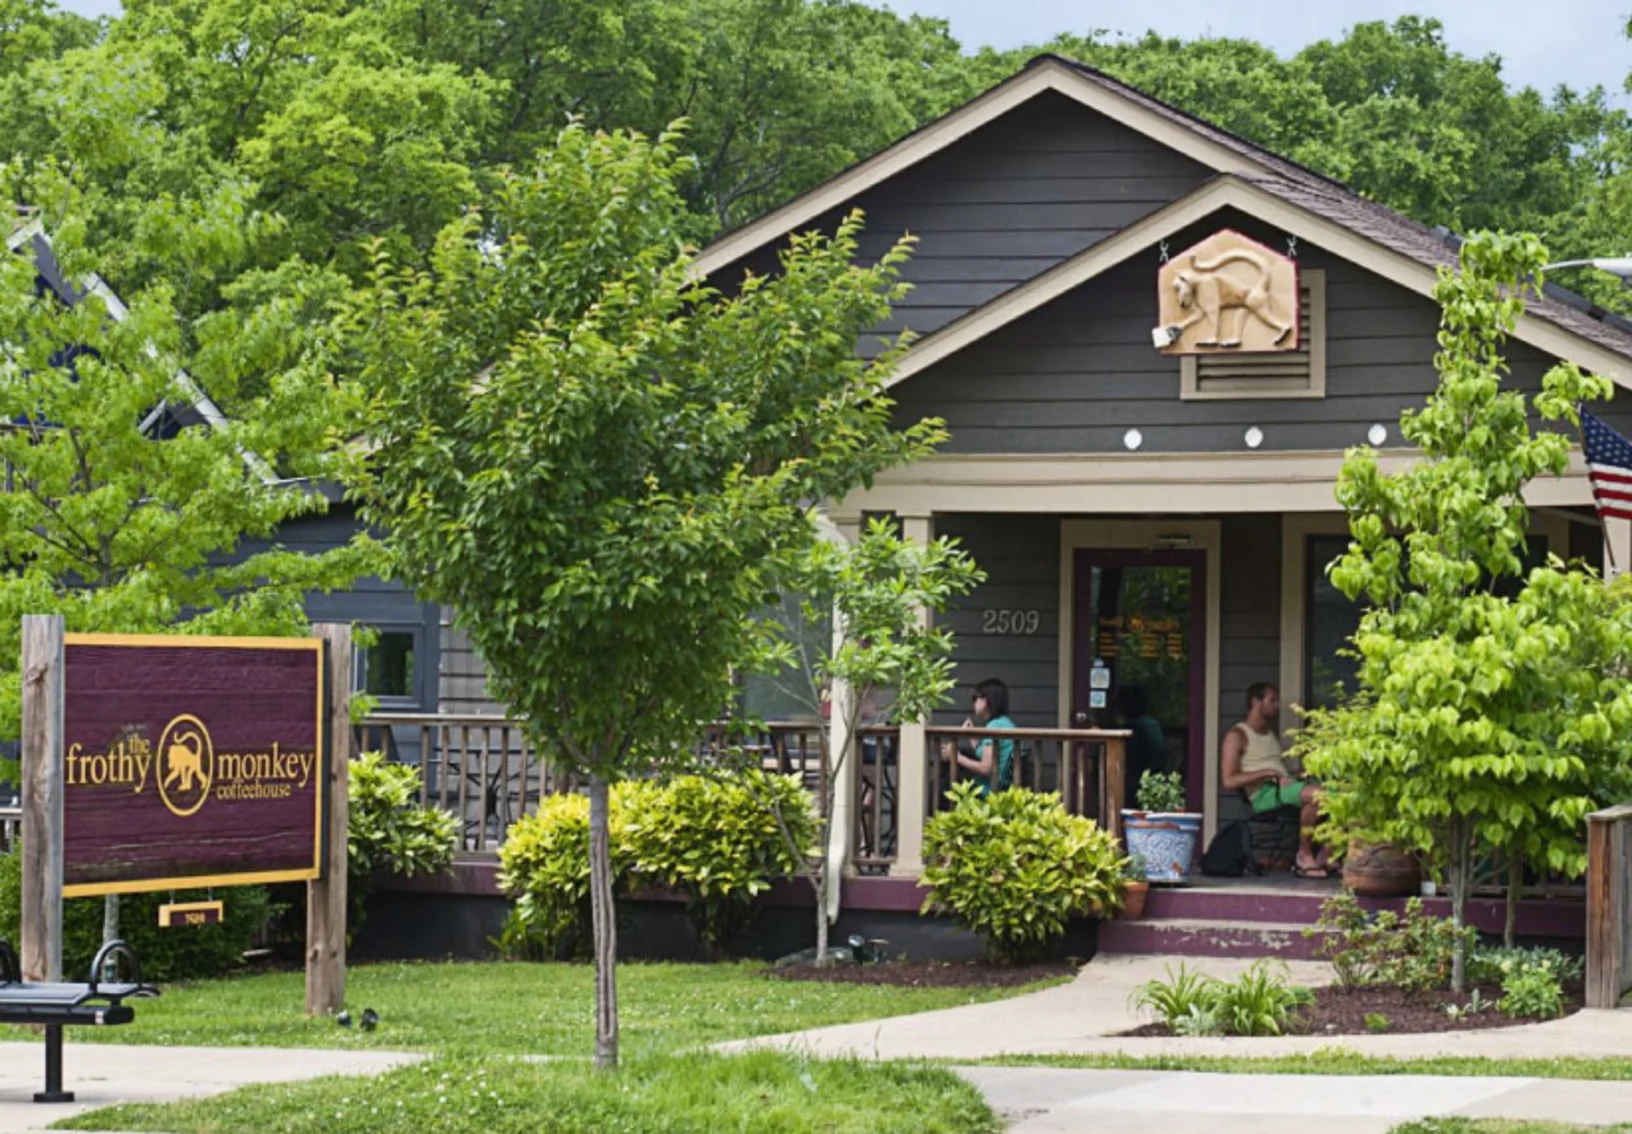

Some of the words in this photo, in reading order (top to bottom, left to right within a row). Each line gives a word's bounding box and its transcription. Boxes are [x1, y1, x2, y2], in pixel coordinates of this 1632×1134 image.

[983, 609, 1039, 634] 2509
[129, 733, 150, 754] the
[66, 742, 151, 793] frothy
[217, 741, 313, 787] monkey
[216, 779, 292, 800] coffeehouse
